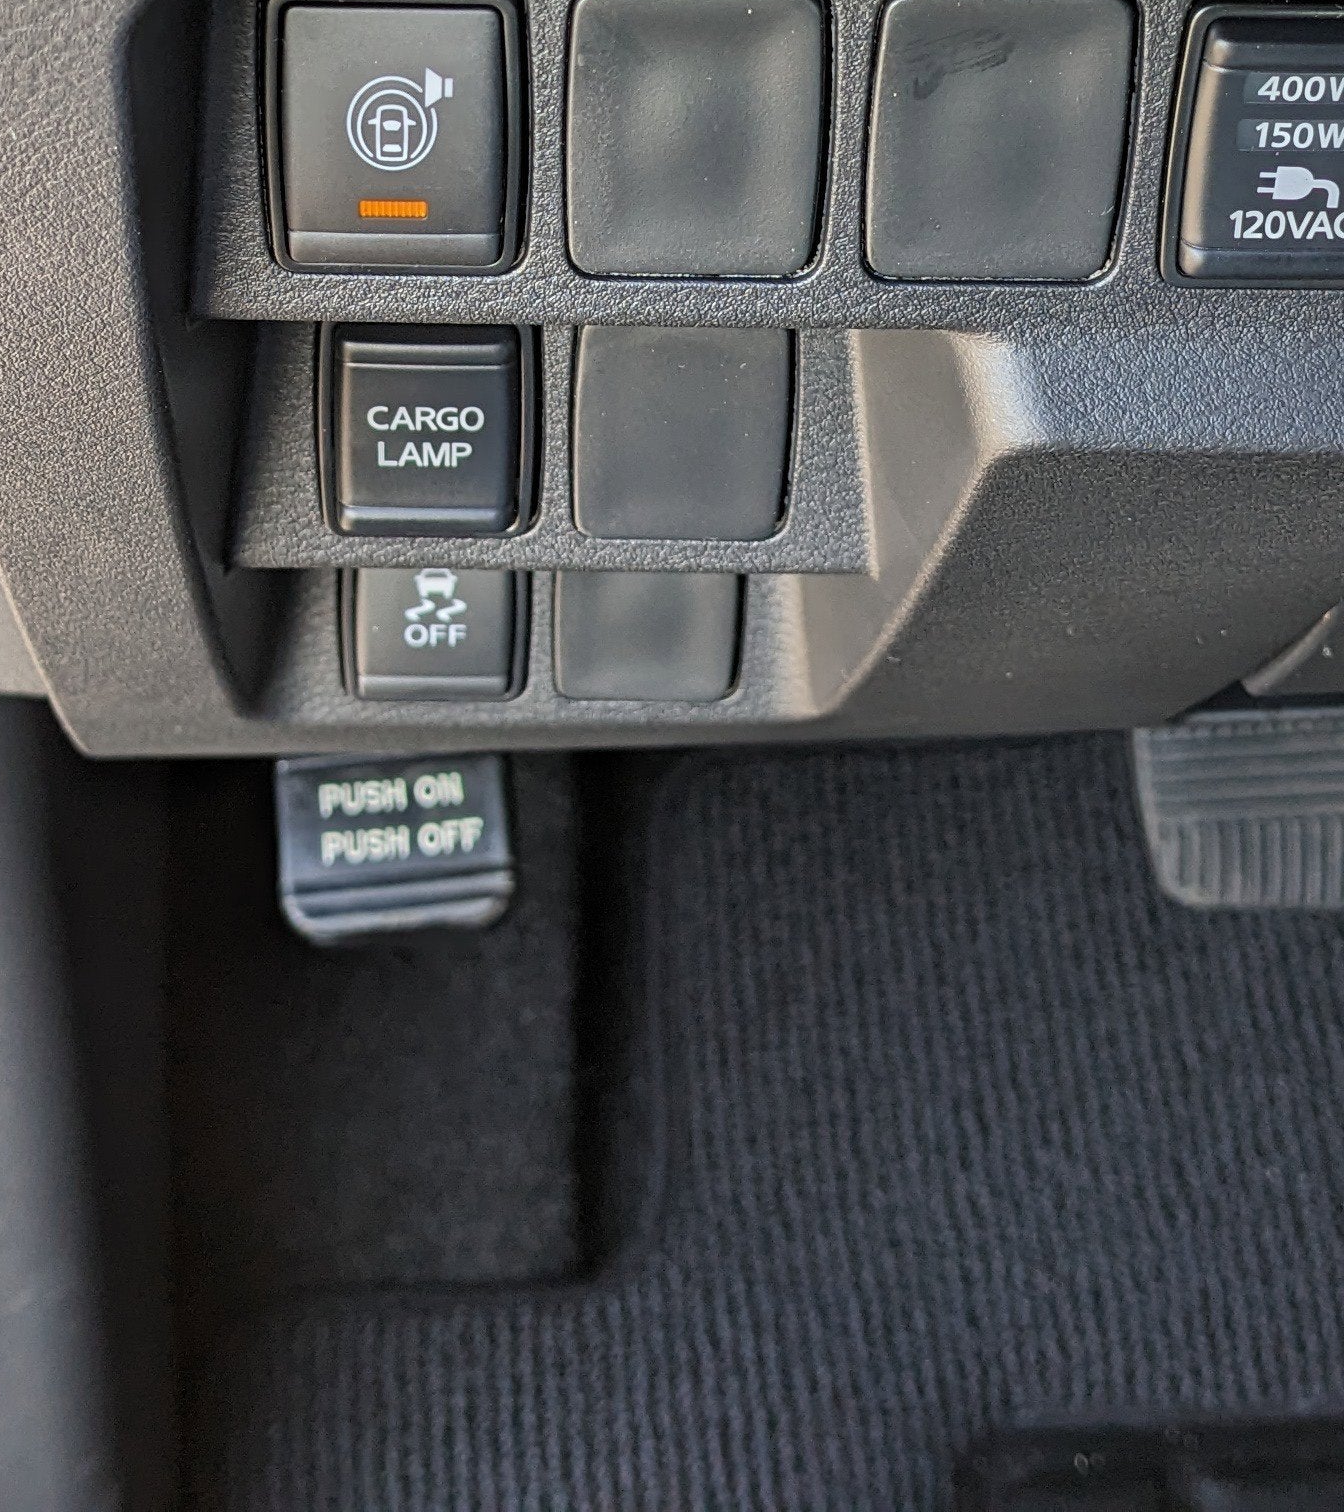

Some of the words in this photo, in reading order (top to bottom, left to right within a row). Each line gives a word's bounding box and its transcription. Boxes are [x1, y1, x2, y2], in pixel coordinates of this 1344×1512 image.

[366, 405, 485, 432] CARGO
[377, 441, 473, 468] LAMP
[404, 623, 467, 648] OFF
[318, 777, 408, 819] PUSH
[413, 771, 464, 809] ON
[320, 824, 411, 867] PUSH
[416, 816, 484, 857] OFF
